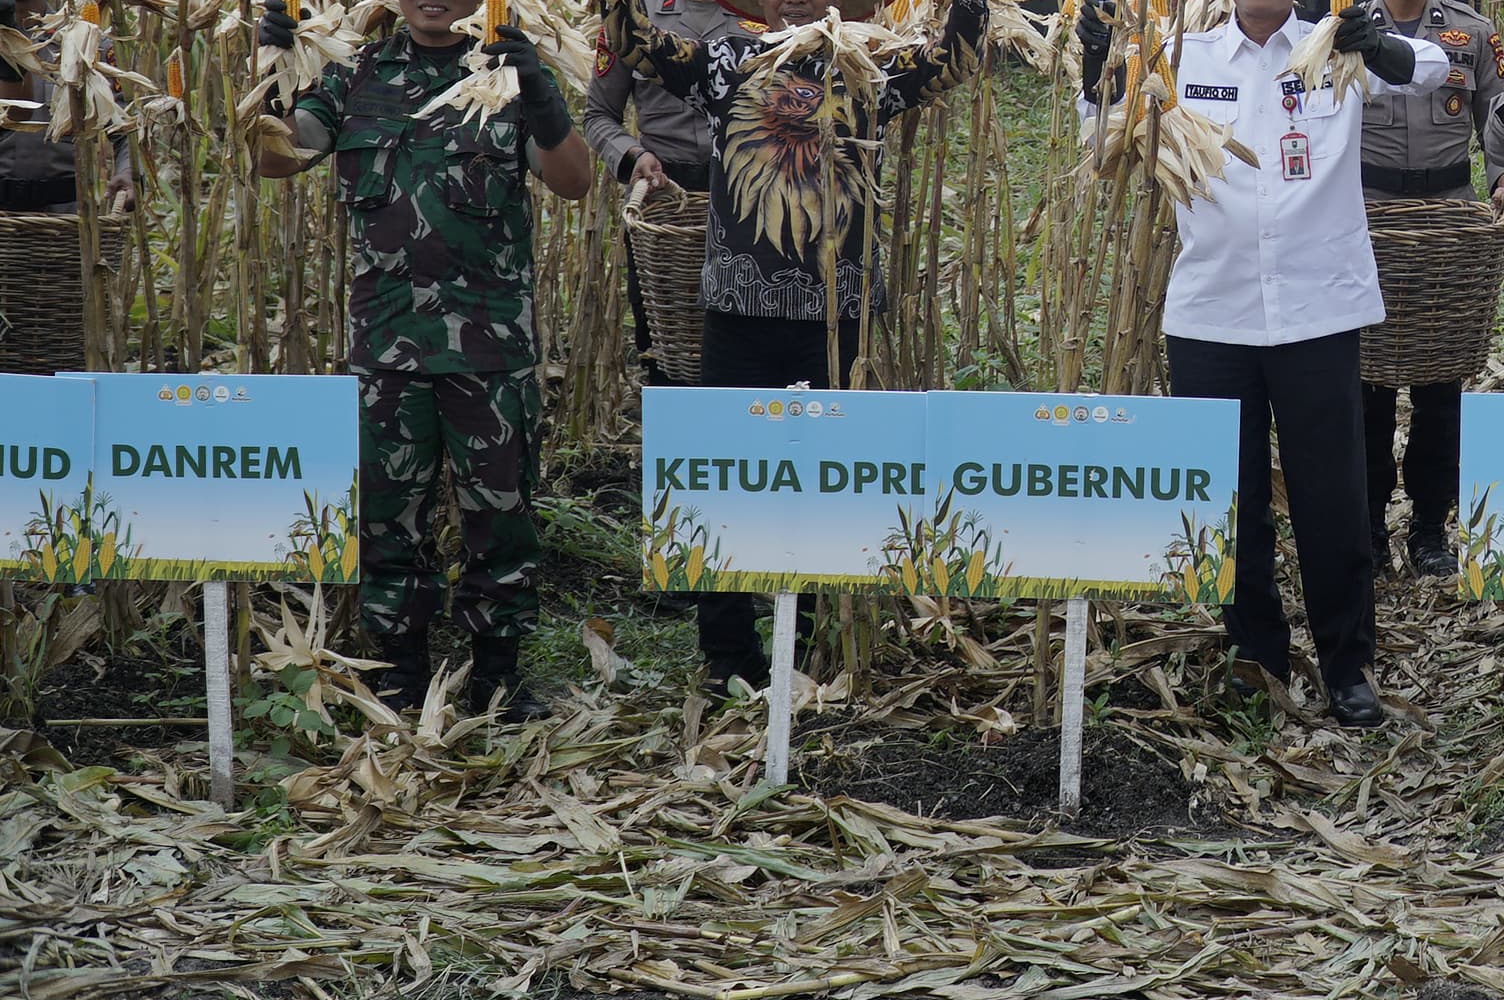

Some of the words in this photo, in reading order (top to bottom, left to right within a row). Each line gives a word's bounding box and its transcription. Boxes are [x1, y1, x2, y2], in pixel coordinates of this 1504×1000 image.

[1445, 51, 1474, 66] OLRI
[0, 444, 71, 480] UD
[111, 444, 303, 480] DANREM
[655, 457, 803, 493] KETUA
[952, 461, 1212, 502] GUBERNUR
